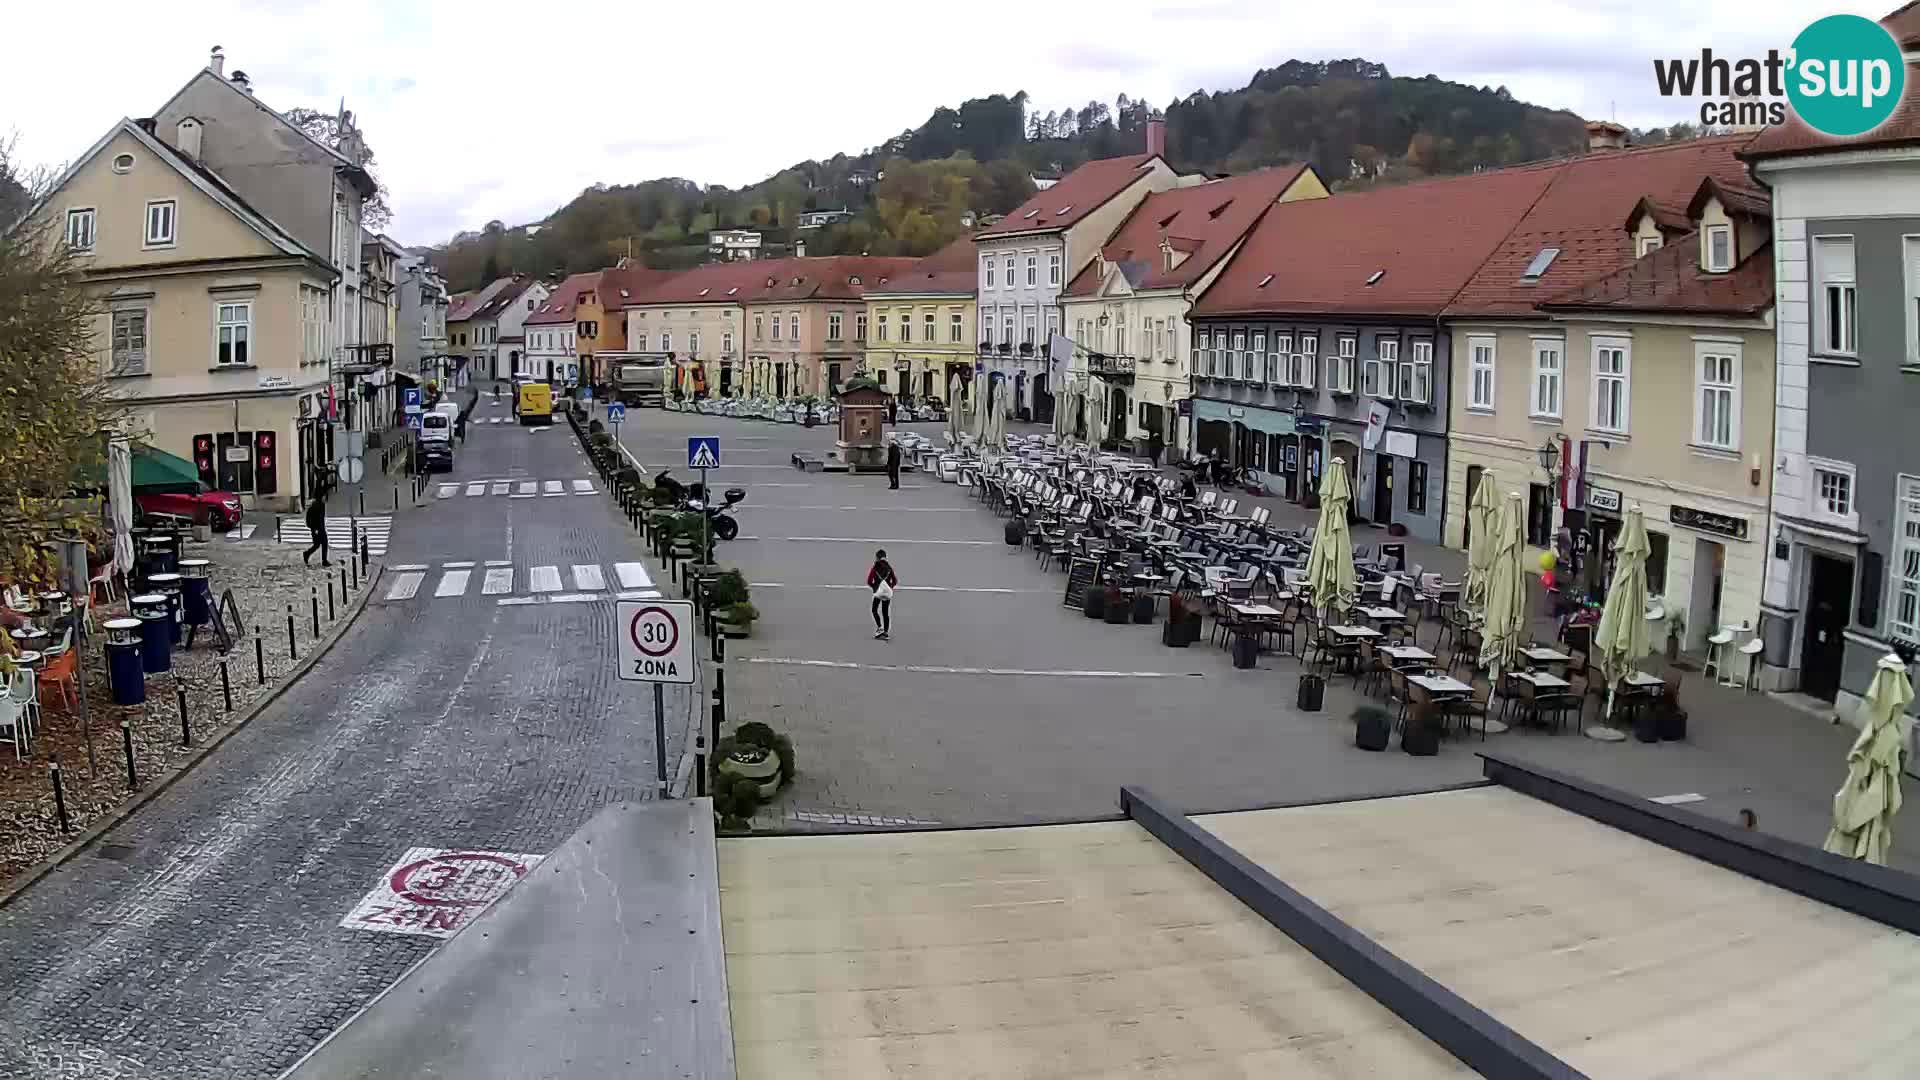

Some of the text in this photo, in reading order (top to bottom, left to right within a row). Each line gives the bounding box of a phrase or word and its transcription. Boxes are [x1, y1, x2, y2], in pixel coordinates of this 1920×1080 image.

[408, 391, 417, 403] P
[643, 622, 667, 643] 30
[633, 659, 678, 677] ZONA
